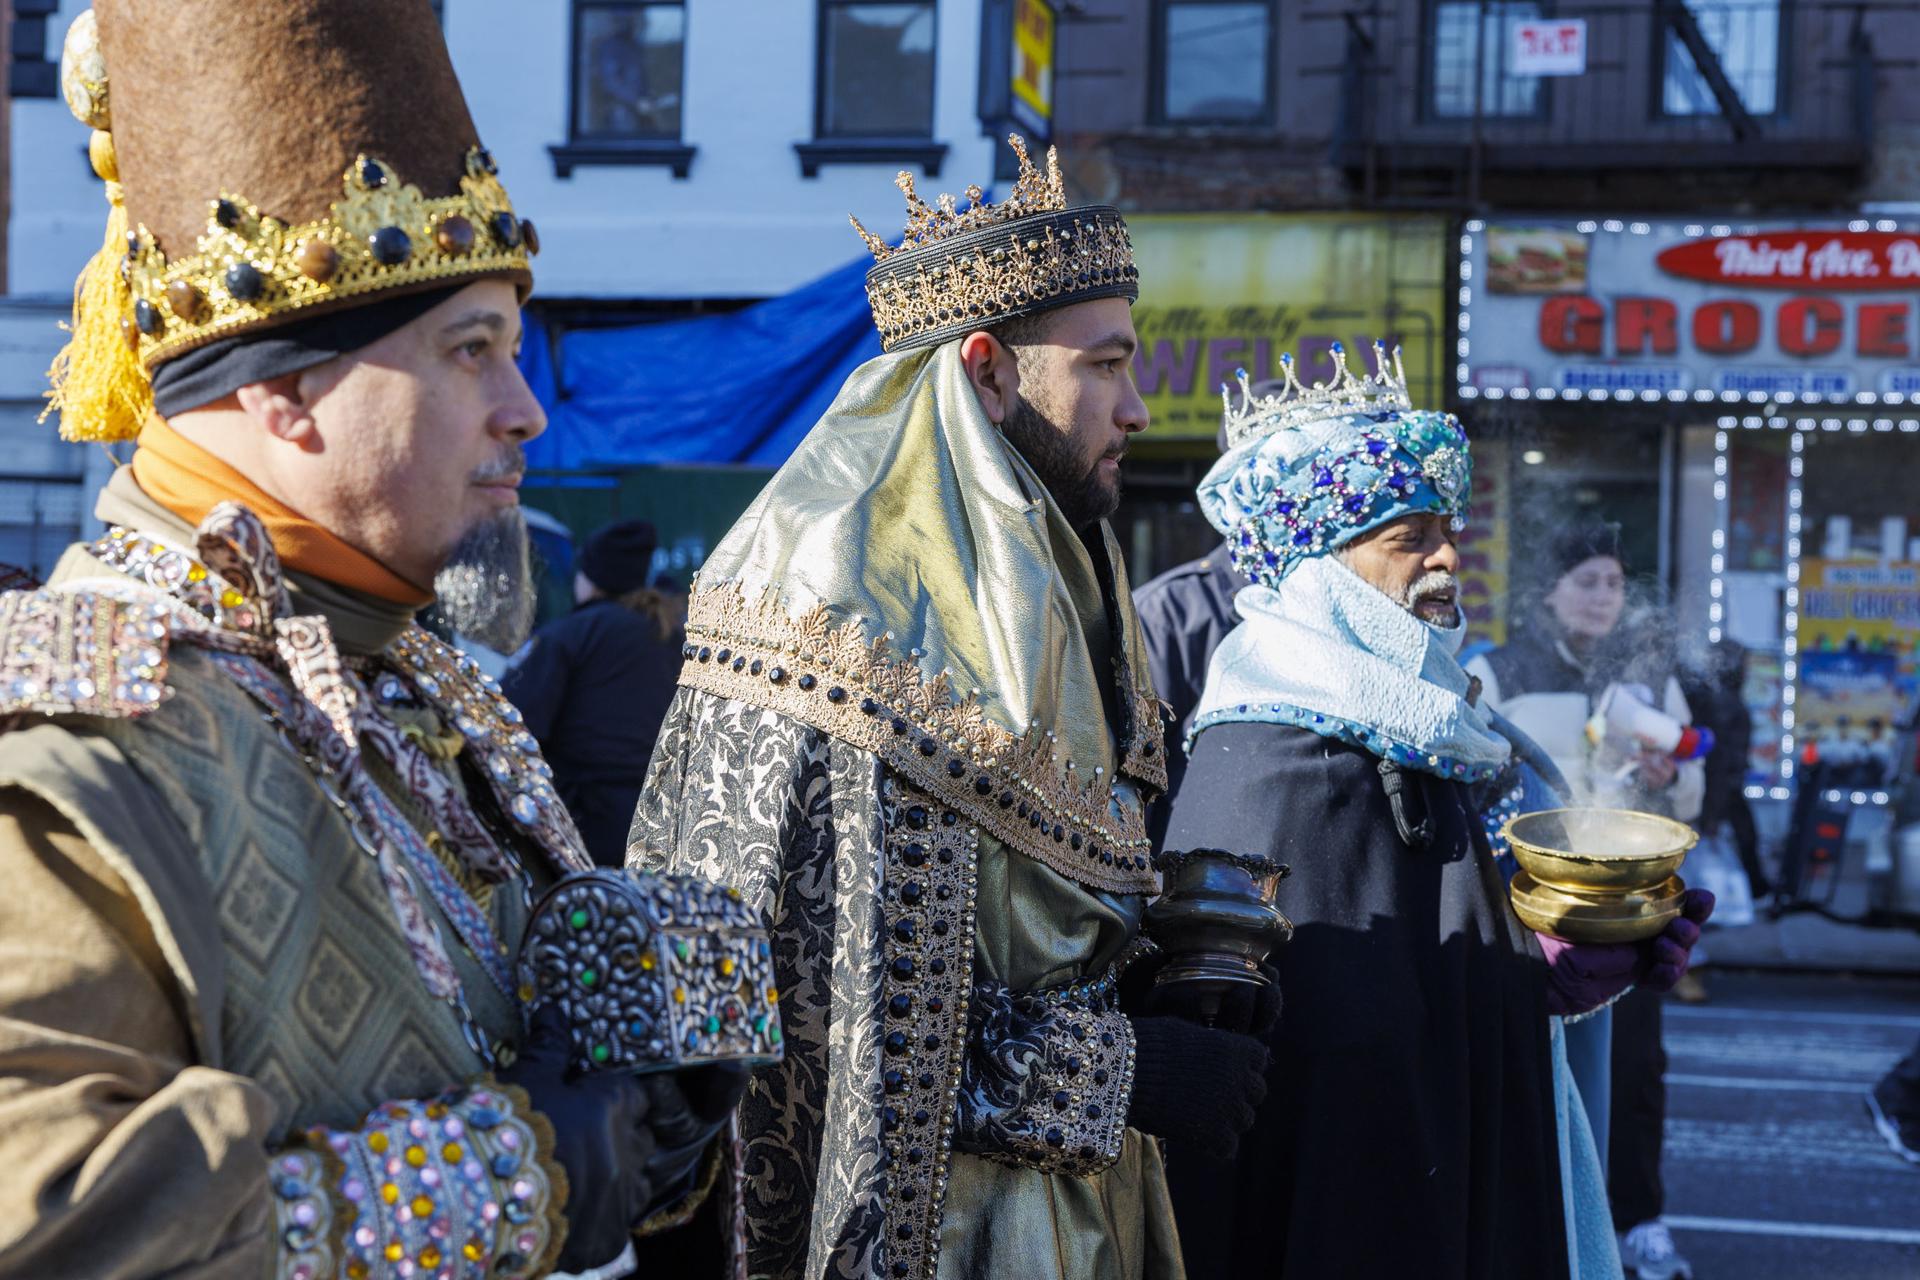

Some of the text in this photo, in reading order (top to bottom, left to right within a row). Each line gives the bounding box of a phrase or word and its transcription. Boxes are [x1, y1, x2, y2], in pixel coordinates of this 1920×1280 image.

[1715, 238, 1807, 275] Third
[1809, 239, 1880, 280] Ave.
[1539, 296, 1909, 355] GROCE
